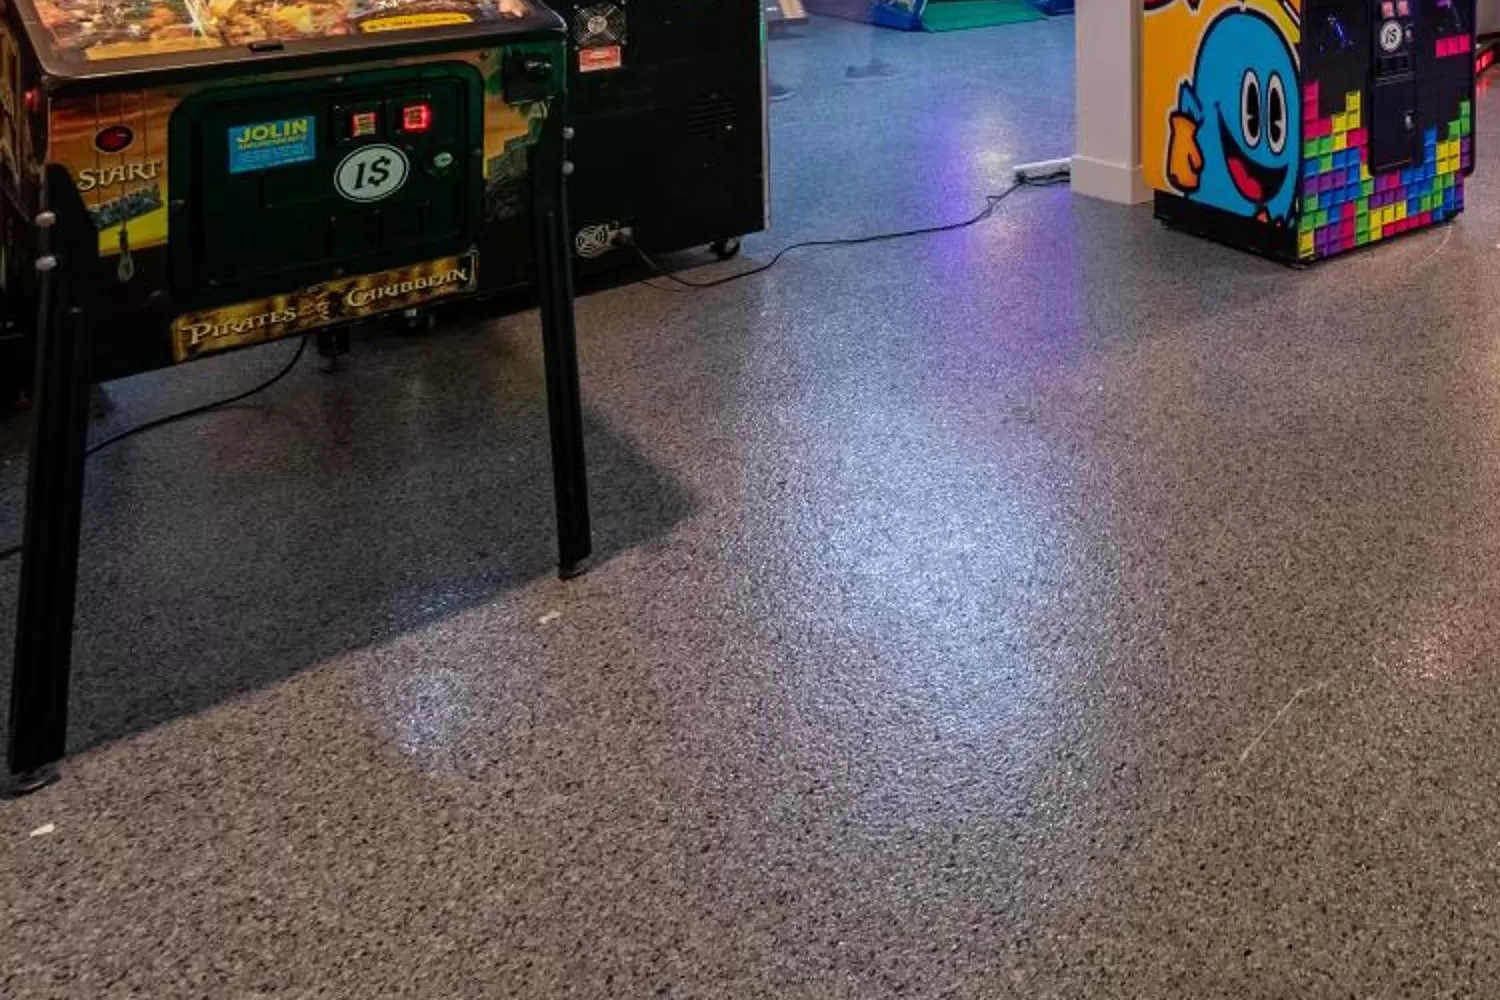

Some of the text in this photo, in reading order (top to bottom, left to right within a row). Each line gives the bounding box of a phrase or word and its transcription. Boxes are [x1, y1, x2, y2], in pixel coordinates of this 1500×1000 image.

[235, 118, 308, 144] JOLIN
[76, 159, 162, 192] START
[352, 154, 392, 190] 1$
[181, 306, 297, 346] PIRATES
